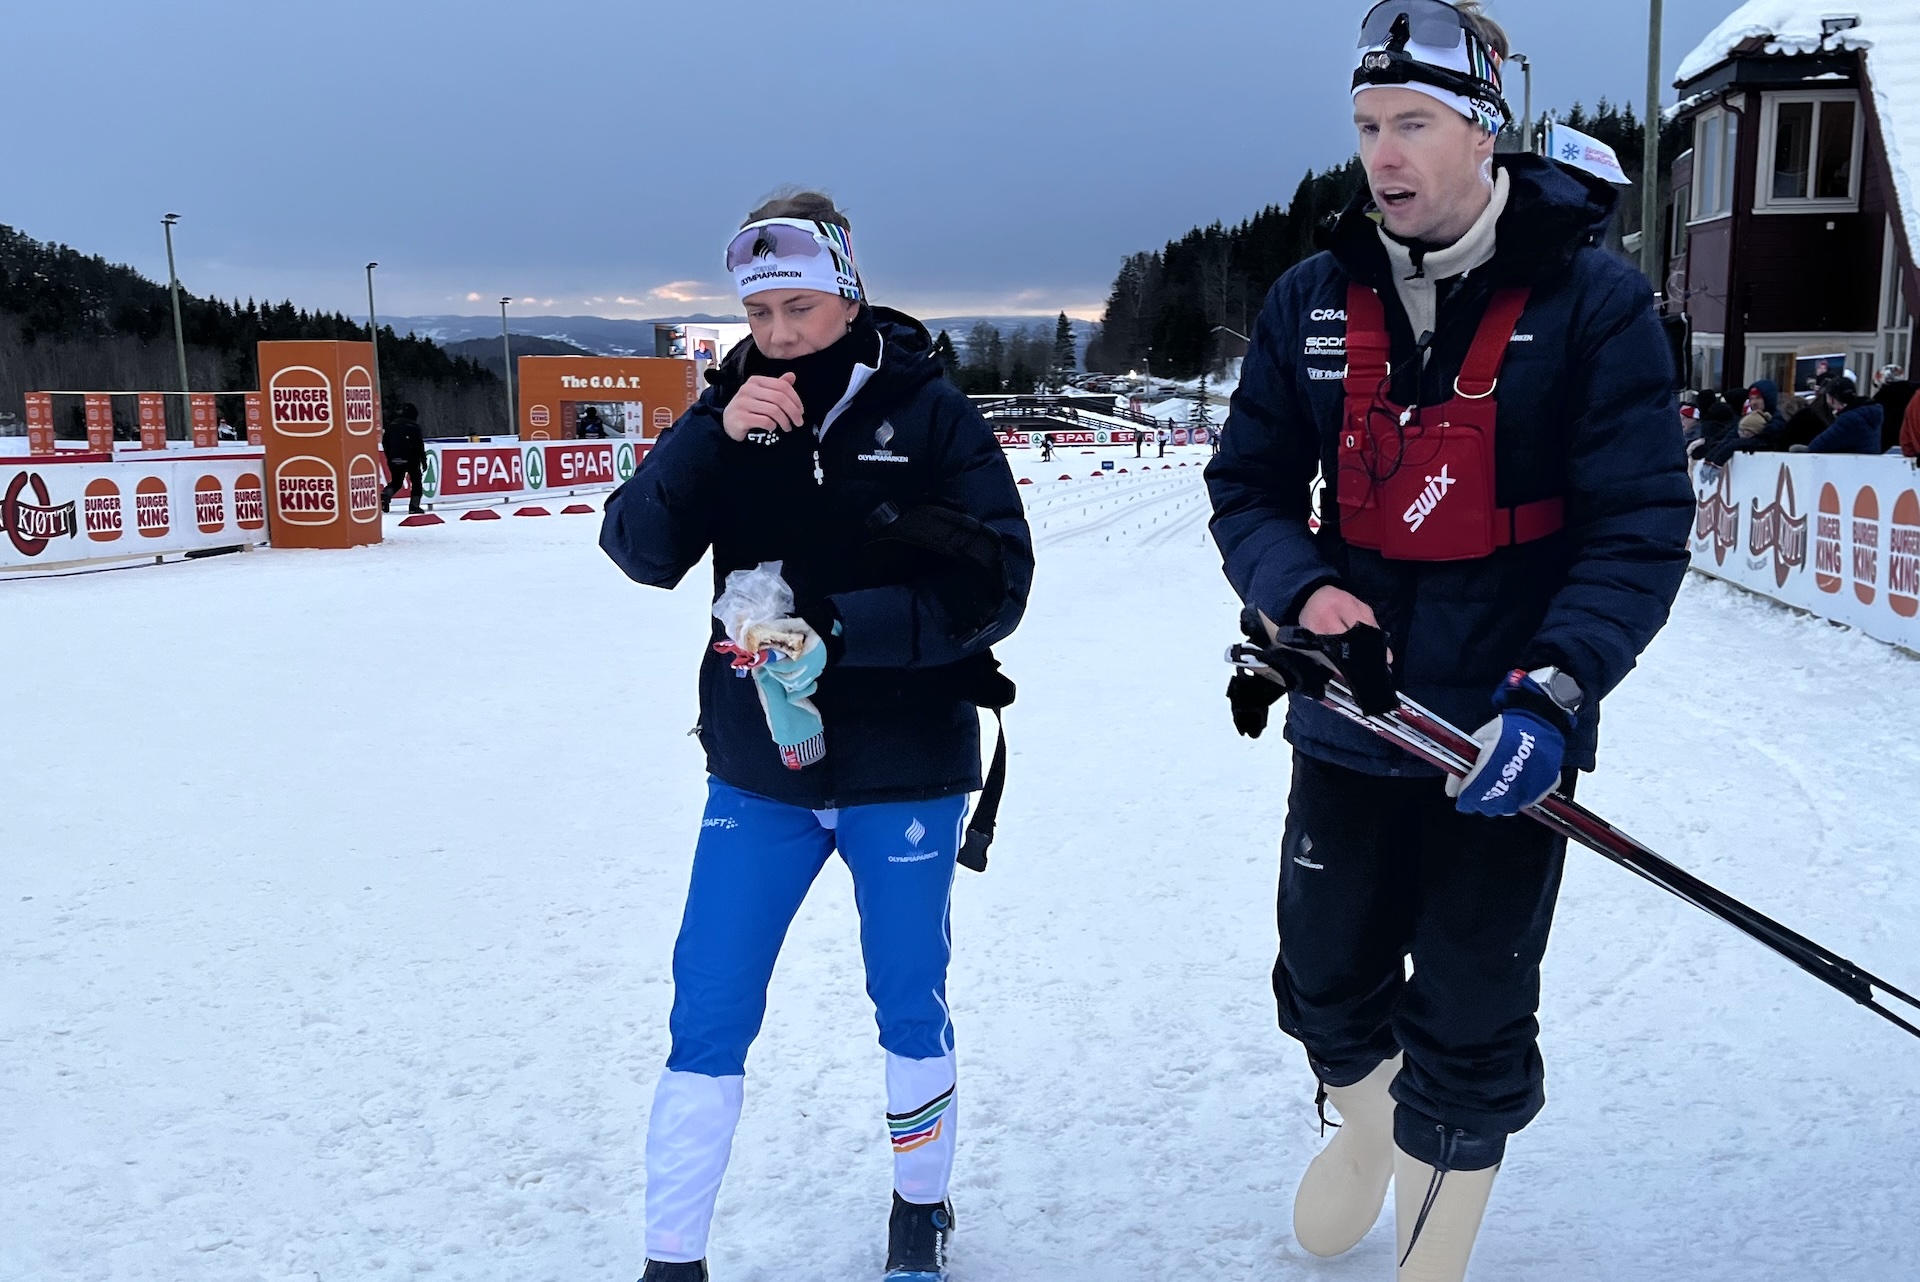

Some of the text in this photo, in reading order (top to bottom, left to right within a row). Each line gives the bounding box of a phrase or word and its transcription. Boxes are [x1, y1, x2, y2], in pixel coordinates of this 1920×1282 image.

[1310, 308, 1348, 321] CRA
[1305, 337, 1347, 348] spor
[561, 375, 641, 389] The G.O.A.T.
[273, 389, 328, 401] BURGER
[345, 389, 371, 401] BURGER
[275, 403, 330, 421] KING
[347, 402, 372, 420] KING
[1055, 434, 1094, 442] SPAR
[1118, 432, 1154, 441] SPR
[457, 456, 523, 487] SPAR
[560, 450, 612, 480] SPAR
[279, 479, 335, 492] BURGER
[85, 497, 121, 511] BURGER
[136, 495, 168, 508] BURGER
[194, 492, 223, 505] BURGER
[280, 493, 336, 511] KING
[351, 489, 377, 509] KING
[17, 505, 68, 535] KJØTT
[85, 511, 122, 531] KING
[137, 508, 169, 527] KING
[196, 505, 224, 523] KING
[1888, 553, 1920, 596] KING
